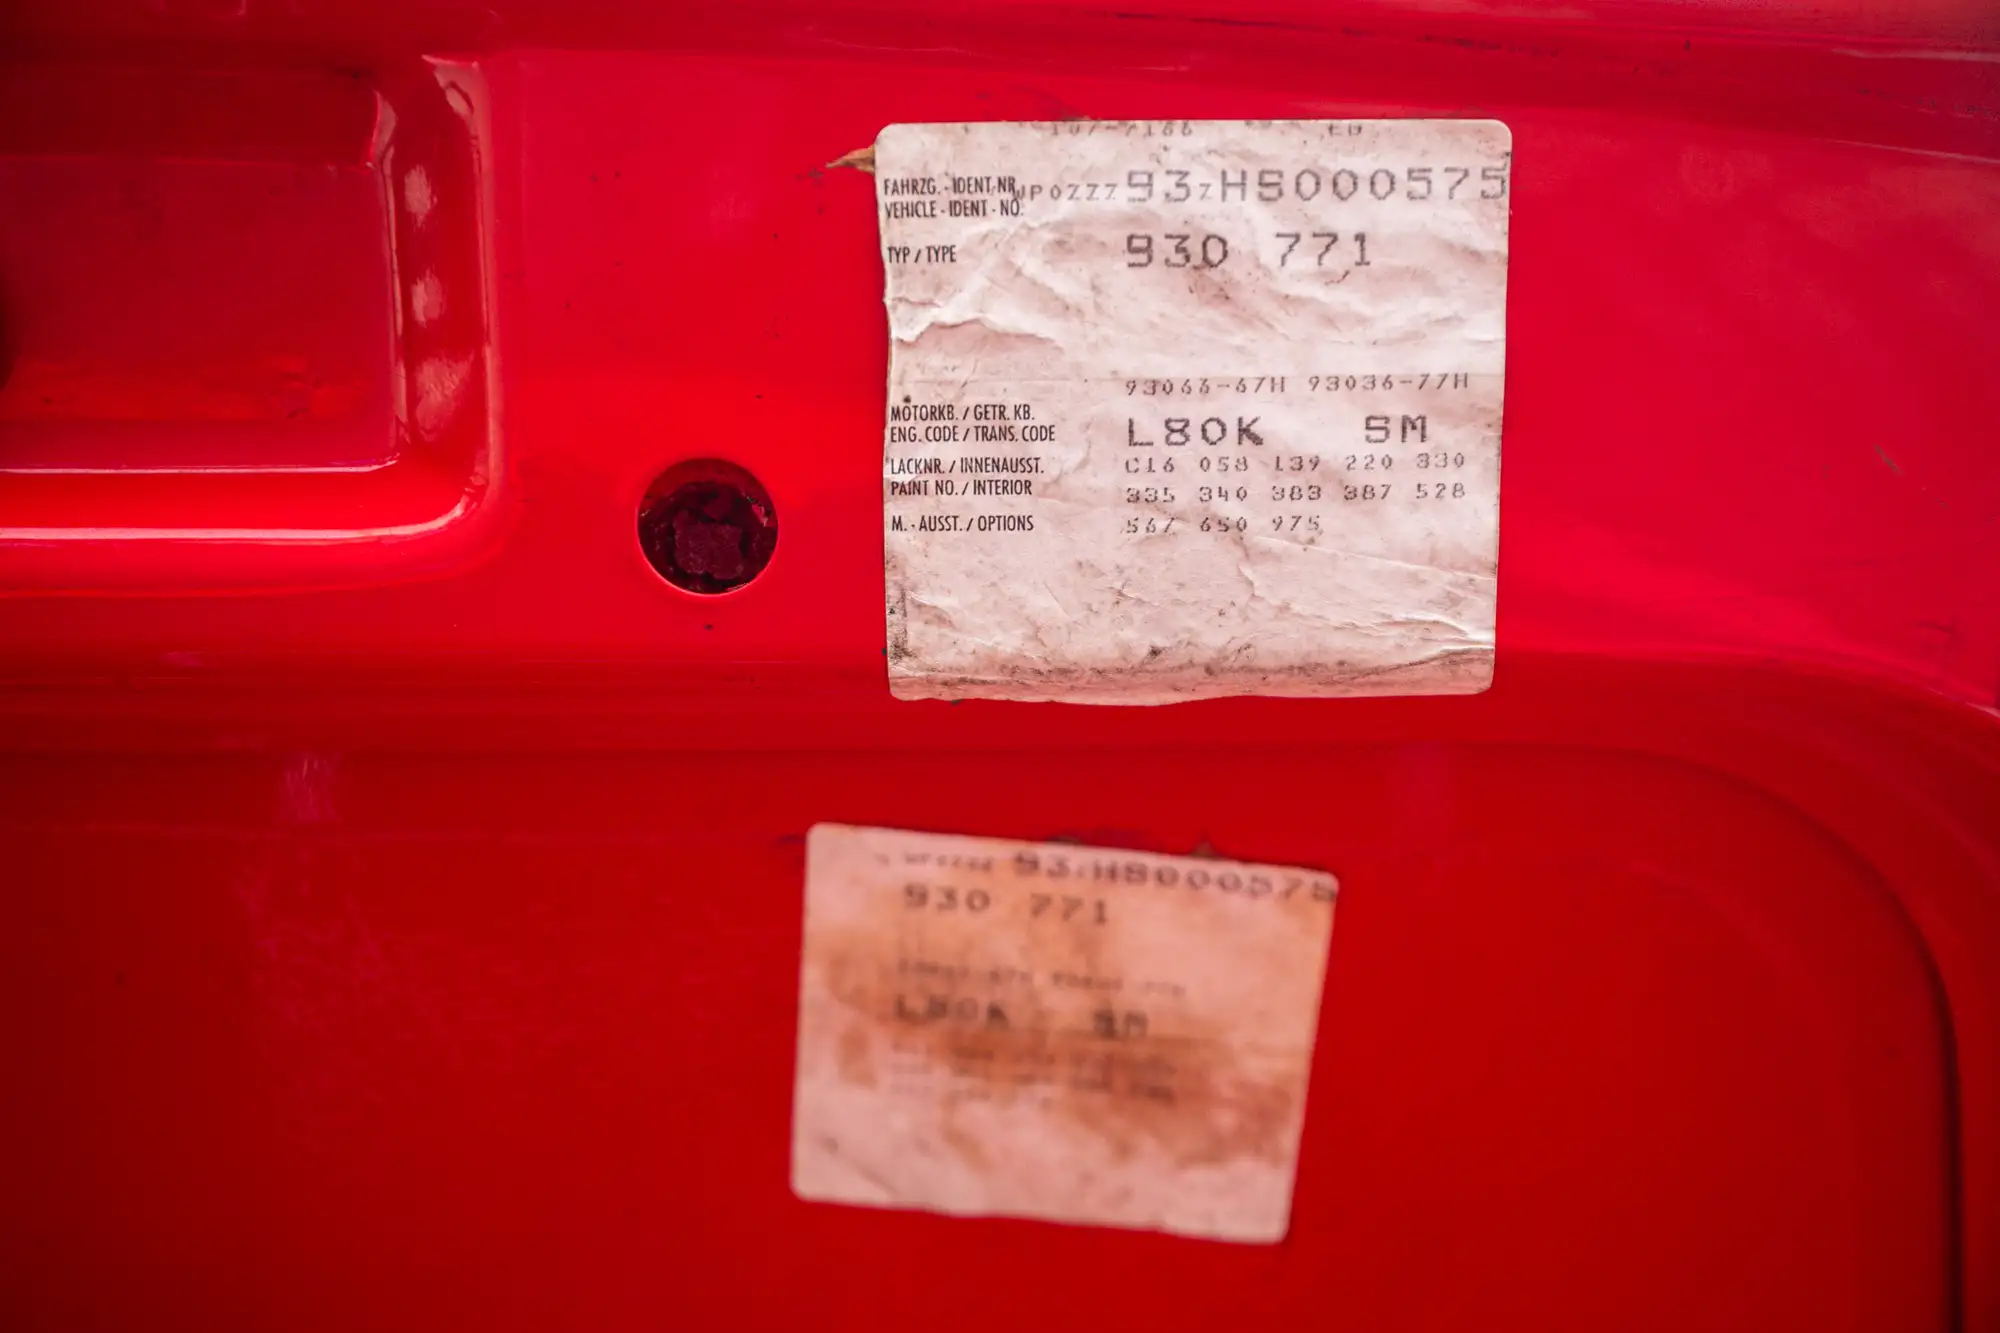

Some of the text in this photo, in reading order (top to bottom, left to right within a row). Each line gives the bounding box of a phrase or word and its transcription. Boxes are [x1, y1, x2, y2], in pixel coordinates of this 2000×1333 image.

[883, 177, 941, 196] FAHRZG.
[884, 200, 938, 219] VEHICLE
[948, 199, 988, 217] IDENT
[887, 246, 910, 264] TYP
[925, 245, 957, 263] TYPE
[1126, 232, 1371, 269] 930 771
[890, 404, 959, 422] MOTORKB.
[973, 404, 1011, 421] GETR.
[1013, 403, 1035, 421] KB.
[890, 426, 922, 443] ENG.
[925, 425, 960, 442] CODE
[973, 426, 1019, 442] TRANS.
[1021, 425, 1056, 442] CODE
[1364, 414, 1428, 444] SM
[890, 458, 946, 475] LACKNR.
[960, 456, 1045, 474] INNENAUSST.
[1125, 457, 1175, 474] C16
[1345, 453, 1393, 471] 220
[890, 480, 930, 497] PAINT
[935, 480, 959, 496] NO.
[973, 479, 1033, 496] INTERIOR
[1199, 485, 1248, 503] 340
[1343, 483, 1392, 501] 387
[1416, 482, 1466, 499] 528
[918, 515, 963, 532] AUSST.
[977, 515, 1035, 532] OPTIONS
[1126, 514, 1321, 533] 567 650 975
